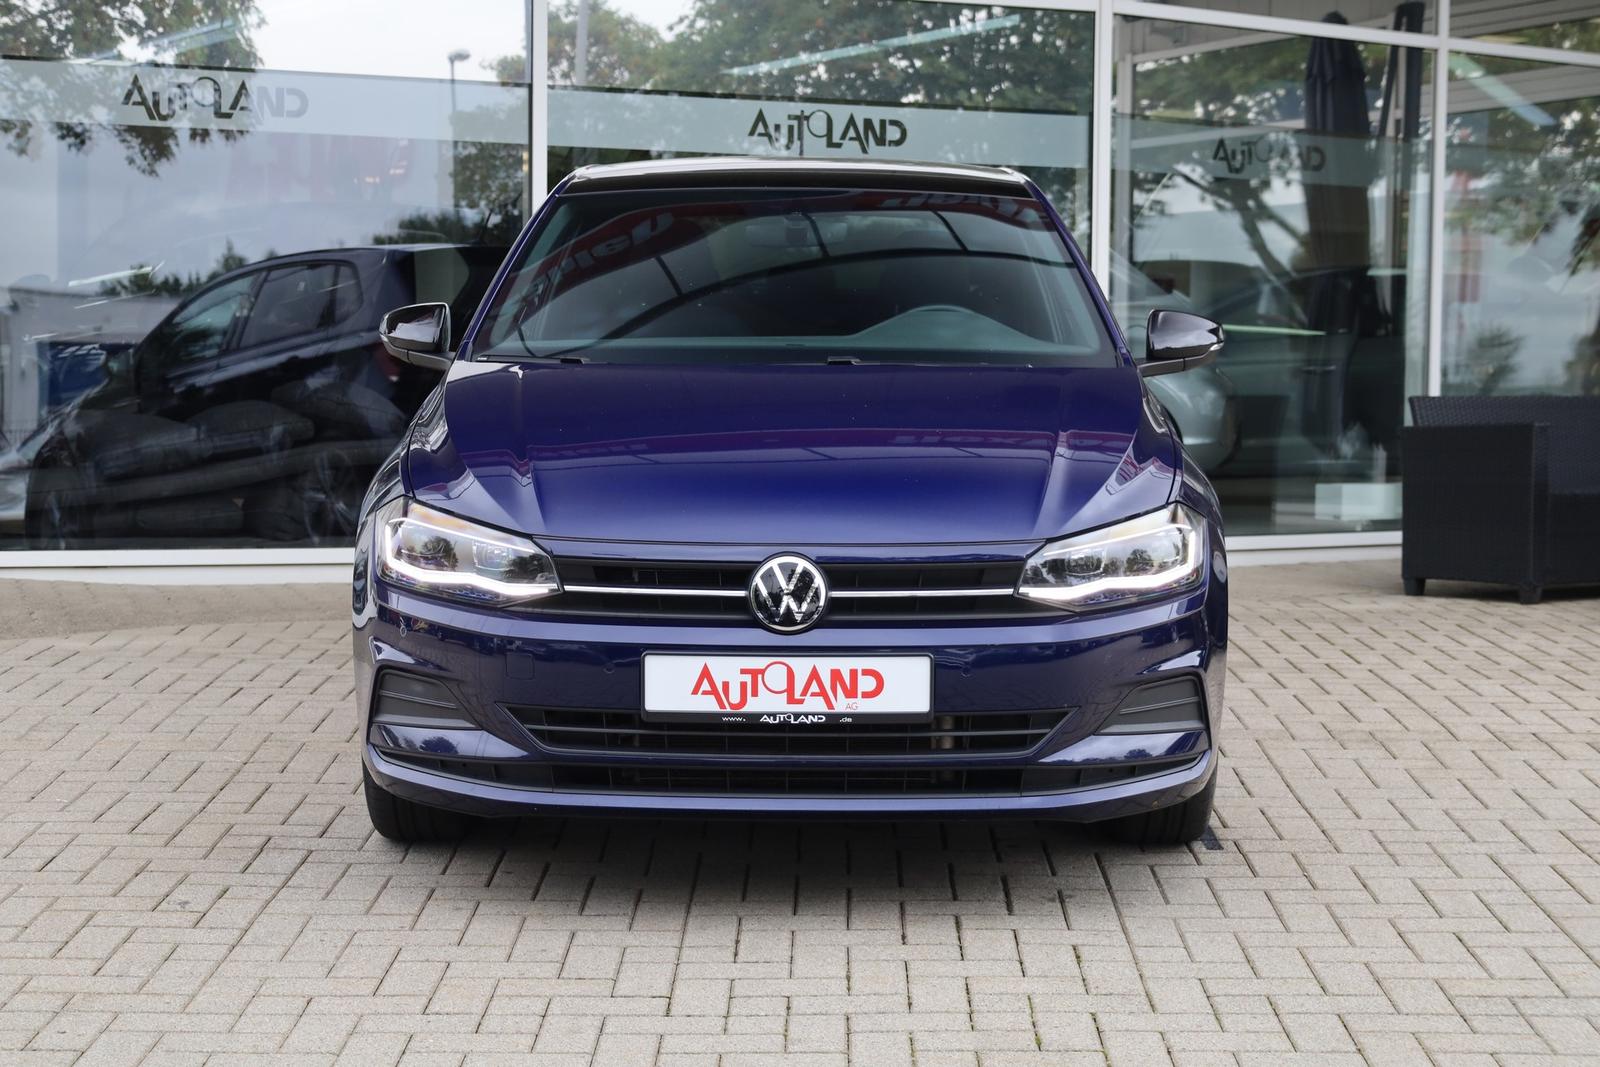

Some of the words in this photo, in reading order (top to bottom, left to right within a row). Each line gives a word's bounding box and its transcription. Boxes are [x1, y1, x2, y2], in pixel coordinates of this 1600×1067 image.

[748, 107, 908, 155] AUTOLAND
[691, 661, 885, 711] AUTOLAND
[759, 712, 826, 724] AUTOLAND
[844, 702, 859, 711] AG
